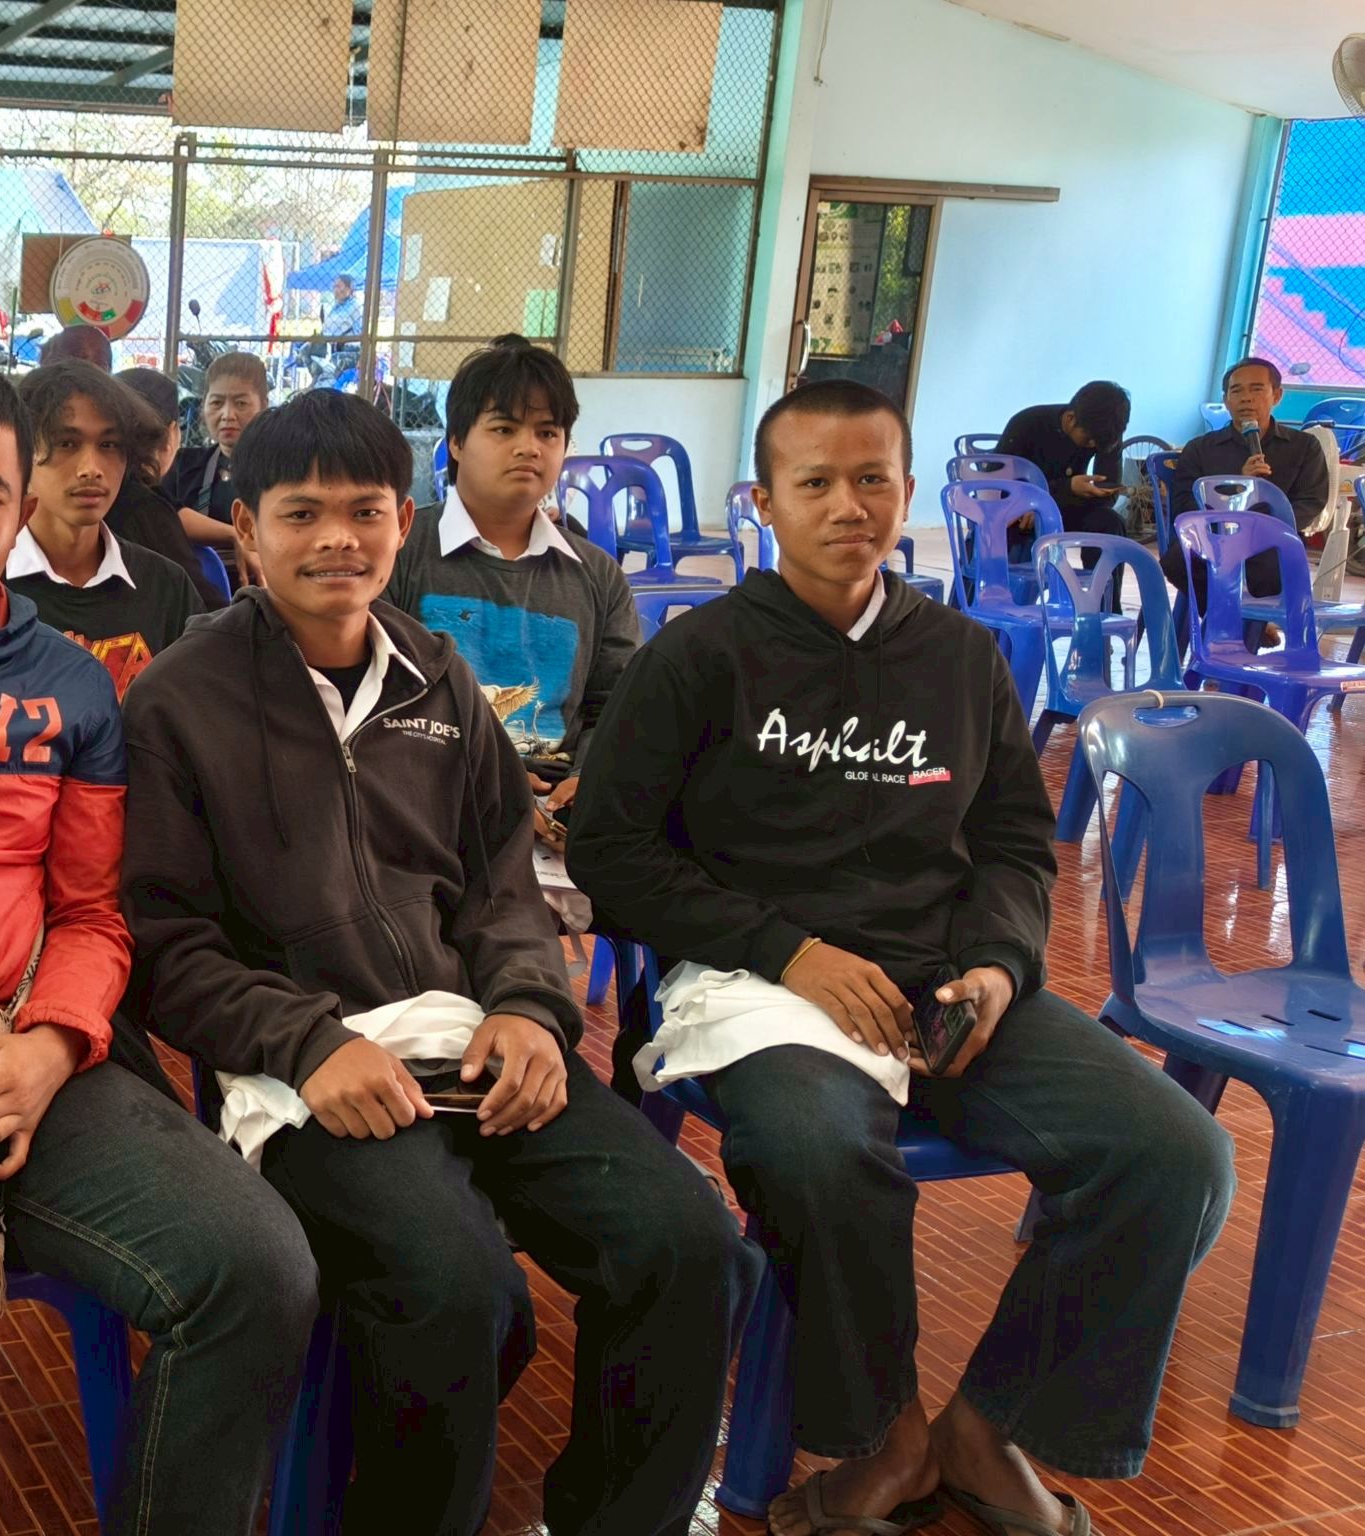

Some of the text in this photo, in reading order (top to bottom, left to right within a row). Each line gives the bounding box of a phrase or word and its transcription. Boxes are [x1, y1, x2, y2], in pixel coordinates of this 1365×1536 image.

[382, 717, 461, 739] SAINT JOE'S
[882, 773, 906, 784] RACE
[912, 767, 947, 779] RACER
